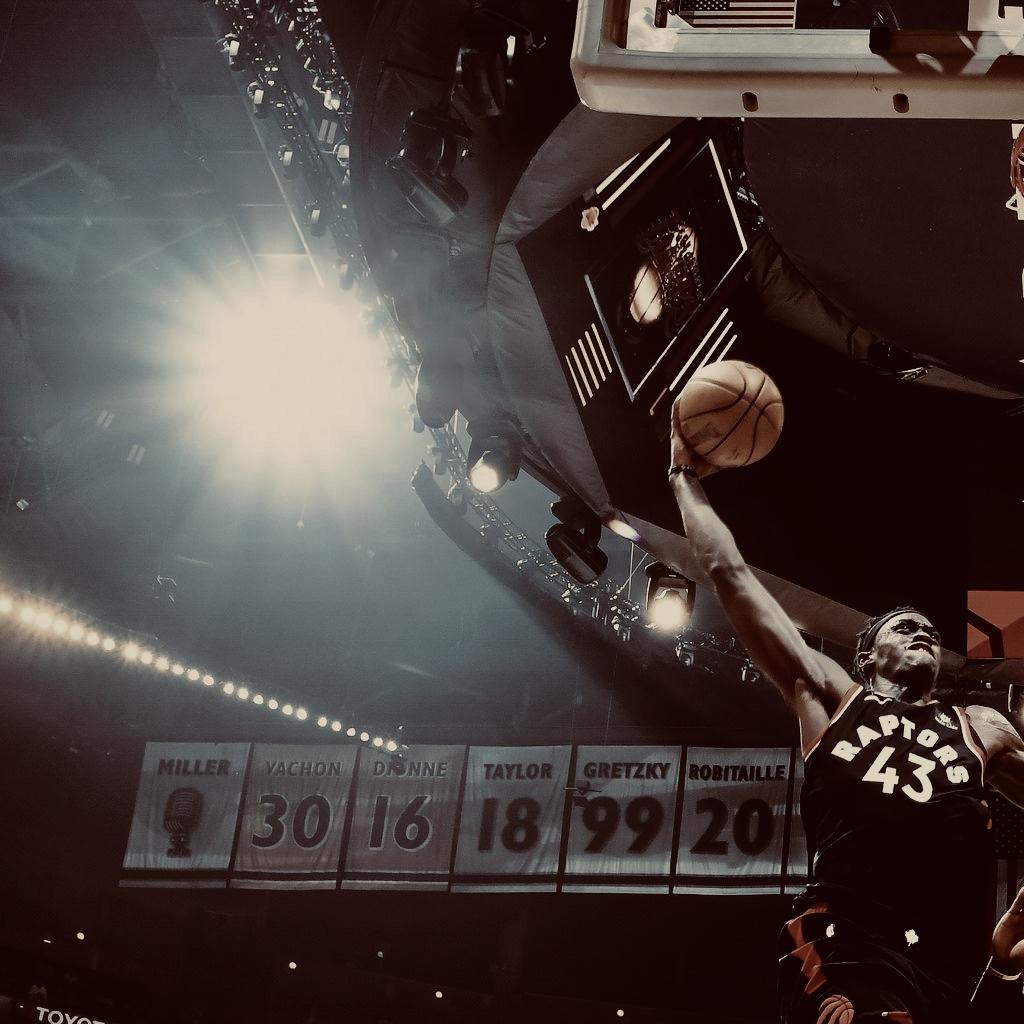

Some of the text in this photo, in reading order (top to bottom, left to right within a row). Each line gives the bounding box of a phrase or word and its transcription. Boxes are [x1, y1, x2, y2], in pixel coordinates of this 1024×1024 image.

[157, 758, 231, 777] MILLER
[372, 760, 448, 778] DIONNE
[483, 762, 554, 780] TAYLOR
[583, 762, 672, 779] GRETZKY
[688, 763, 786, 782] ROBITAILLE
[831, 713, 970, 784] RAPTORS
[861, 745, 937, 803] 43
[252, 793, 333, 849] 30
[368, 795, 432, 850] 16
[477, 797, 542, 852] 18
[581, 796, 666, 853] 99
[689, 797, 775, 856] 20
